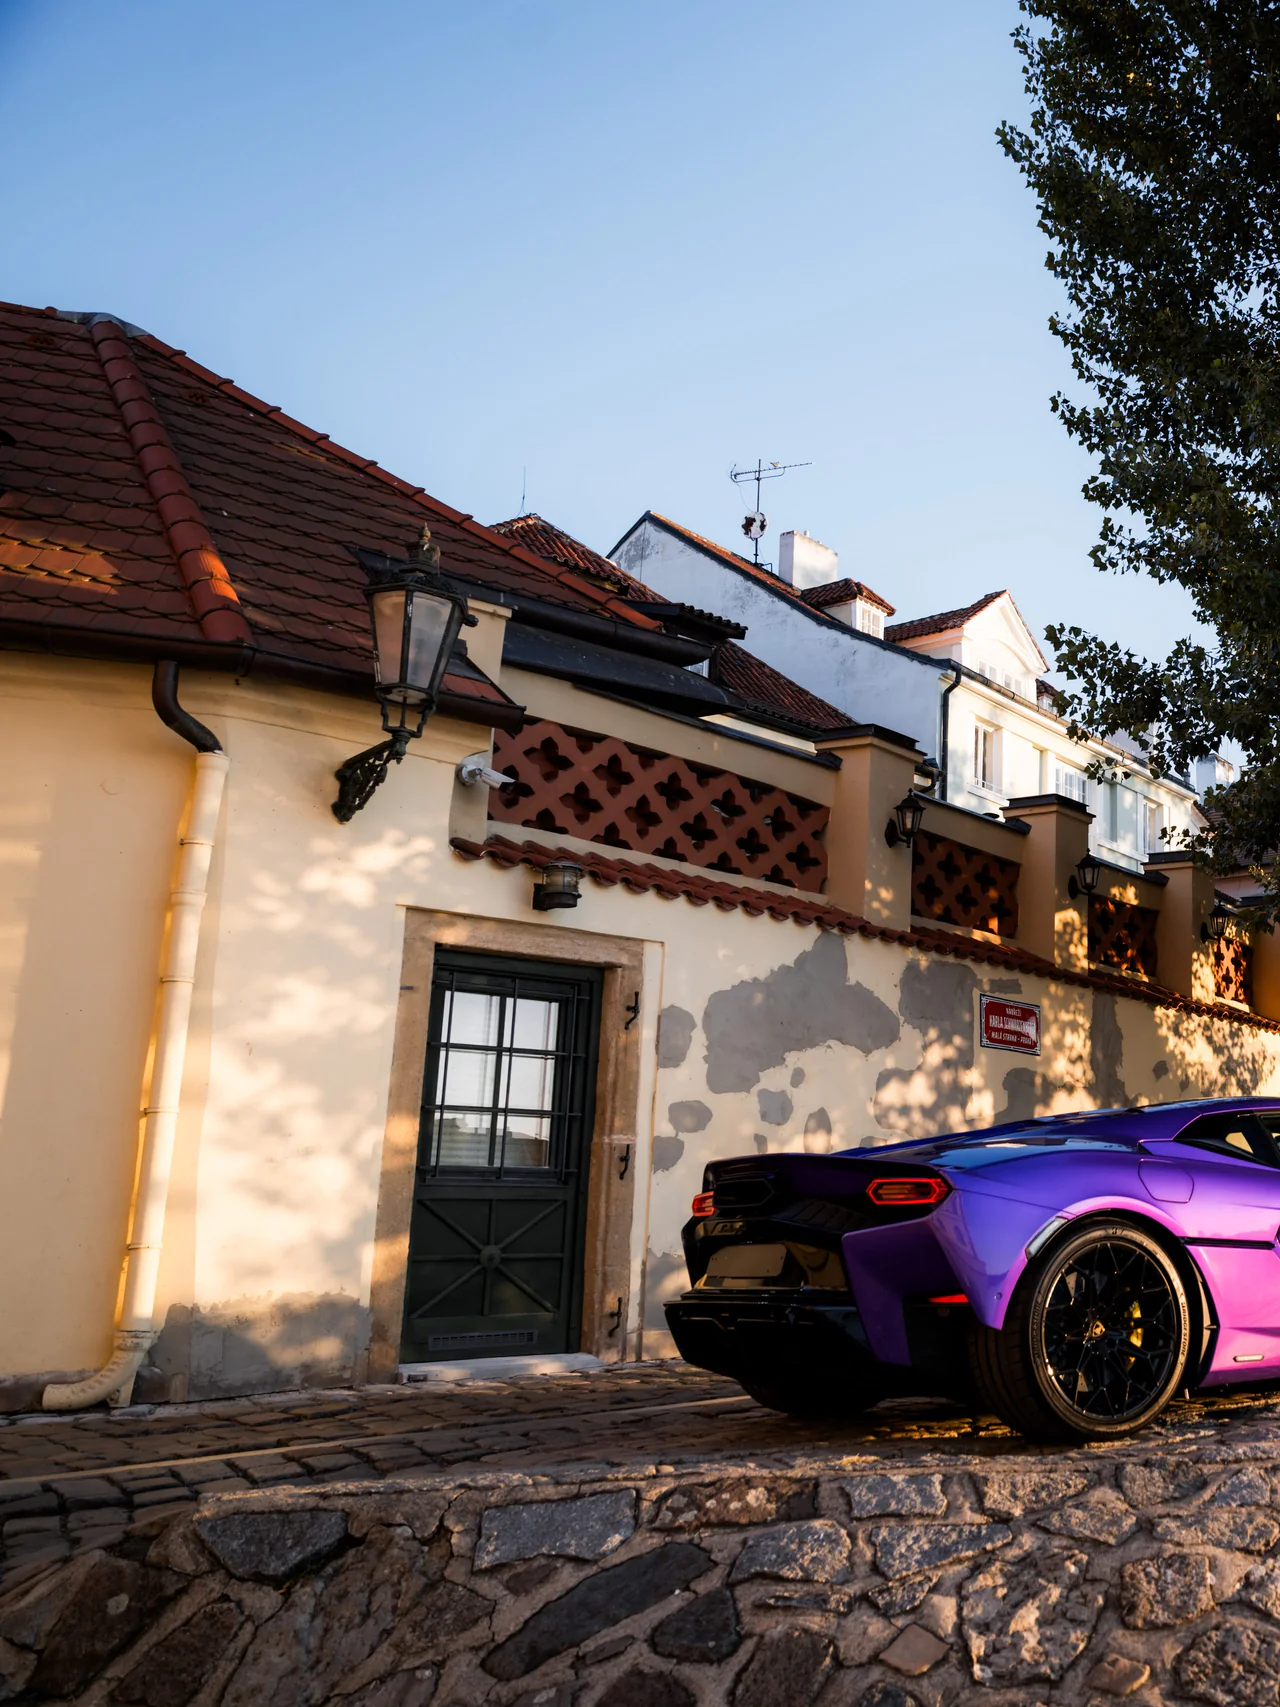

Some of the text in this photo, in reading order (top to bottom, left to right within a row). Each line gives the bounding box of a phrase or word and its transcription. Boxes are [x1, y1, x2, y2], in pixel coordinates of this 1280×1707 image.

[989, 1014, 1003, 1028] KARLA
[991, 1031, 1002, 1039] MALÁ
[1003, 1033, 1017, 1042] STRANA
[1180, 1302, 1189, 1355] BRIDGESTONE
